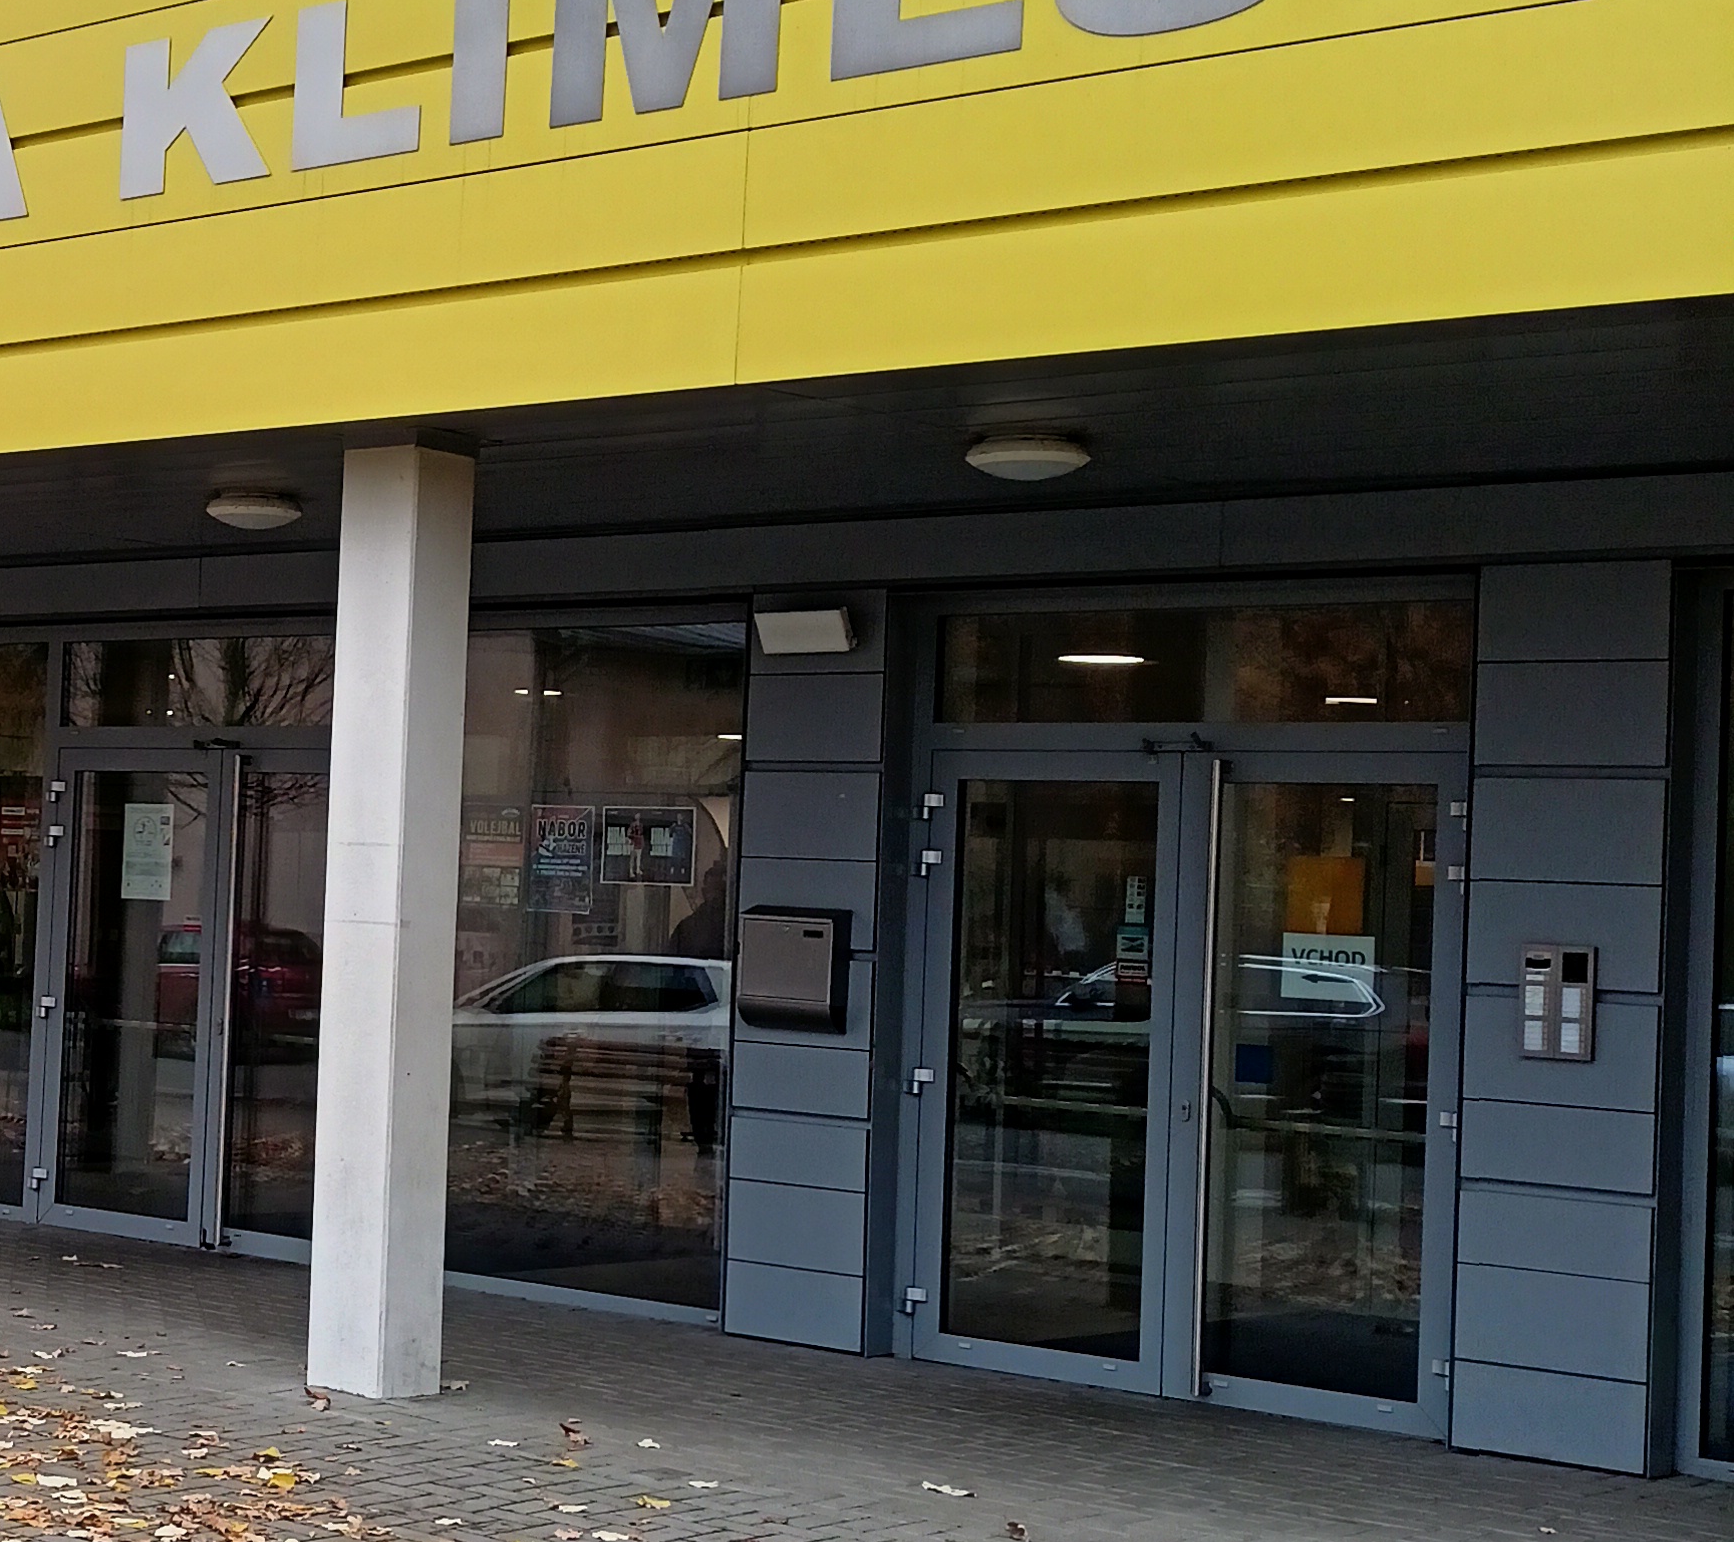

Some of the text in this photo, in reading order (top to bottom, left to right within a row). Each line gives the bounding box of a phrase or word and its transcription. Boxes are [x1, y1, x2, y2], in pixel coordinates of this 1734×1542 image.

[469, 819, 522, 835] VOLEJBAL
[537, 816, 586, 838] NÁBOR
[1291, 947, 1366, 967] VCHOD
